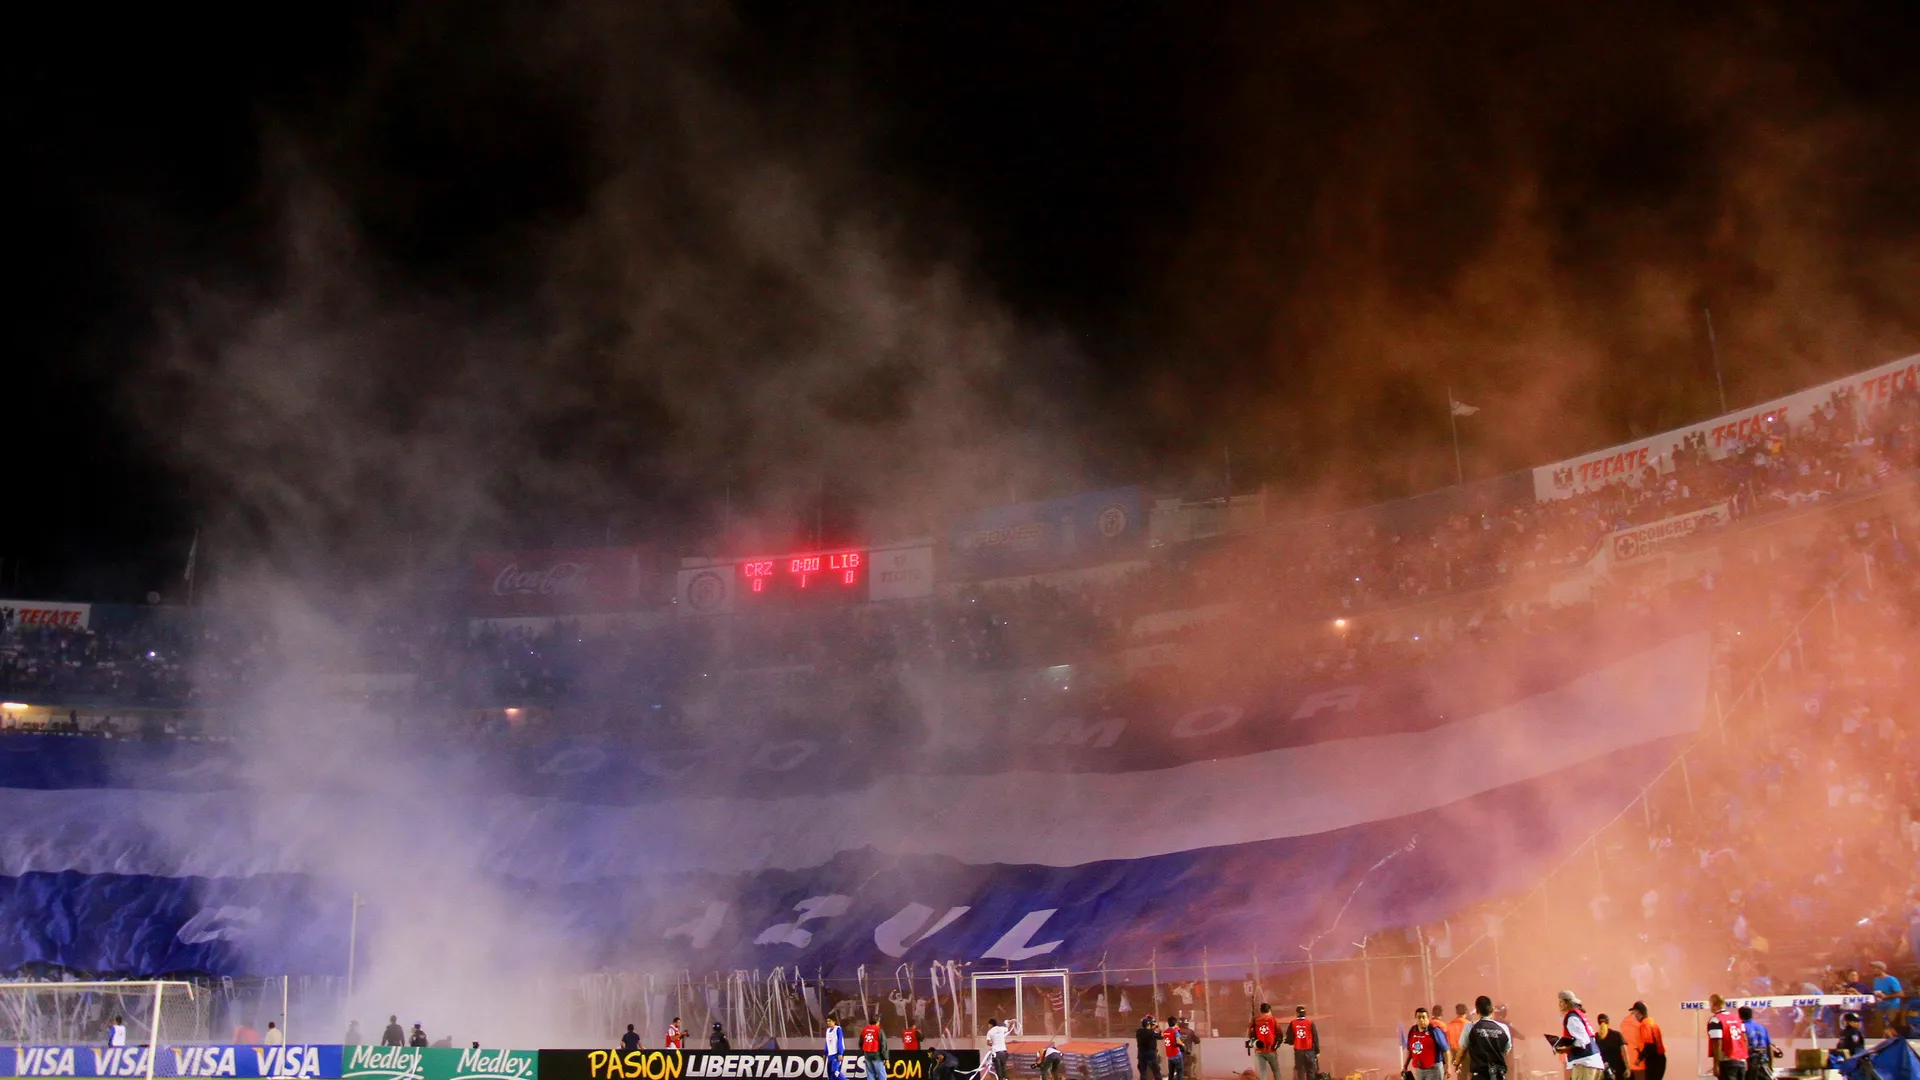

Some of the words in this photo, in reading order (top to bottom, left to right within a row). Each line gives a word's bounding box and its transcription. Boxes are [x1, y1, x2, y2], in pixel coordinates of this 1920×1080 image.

[1862, 364, 1920, 403] TECA
[1578, 447, 1649, 482] TECATE
[744, 560, 774, 577] CRZ
[790, 557, 820, 573] 0:00
[830, 553, 860, 570] LIB
[753, 578, 763, 593] 0
[845, 570, 854, 584] 0
[19, 608, 83, 626] TECATE
[1681, 1002, 1704, 1010] EMME
[1725, 1001, 1737, 1009] ME
[1744, 1000, 1773, 1008] EMME
[1792, 998, 1820, 1007] EMME
[1842, 996, 1870, 1004] EMME
[15, 1048, 75, 1077] VISA
[91, 1047, 150, 1076] VISA
[170, 1047, 236, 1077] VISA
[252, 1047, 320, 1077] VISA
[588, 1050, 683, 1080] PASION
